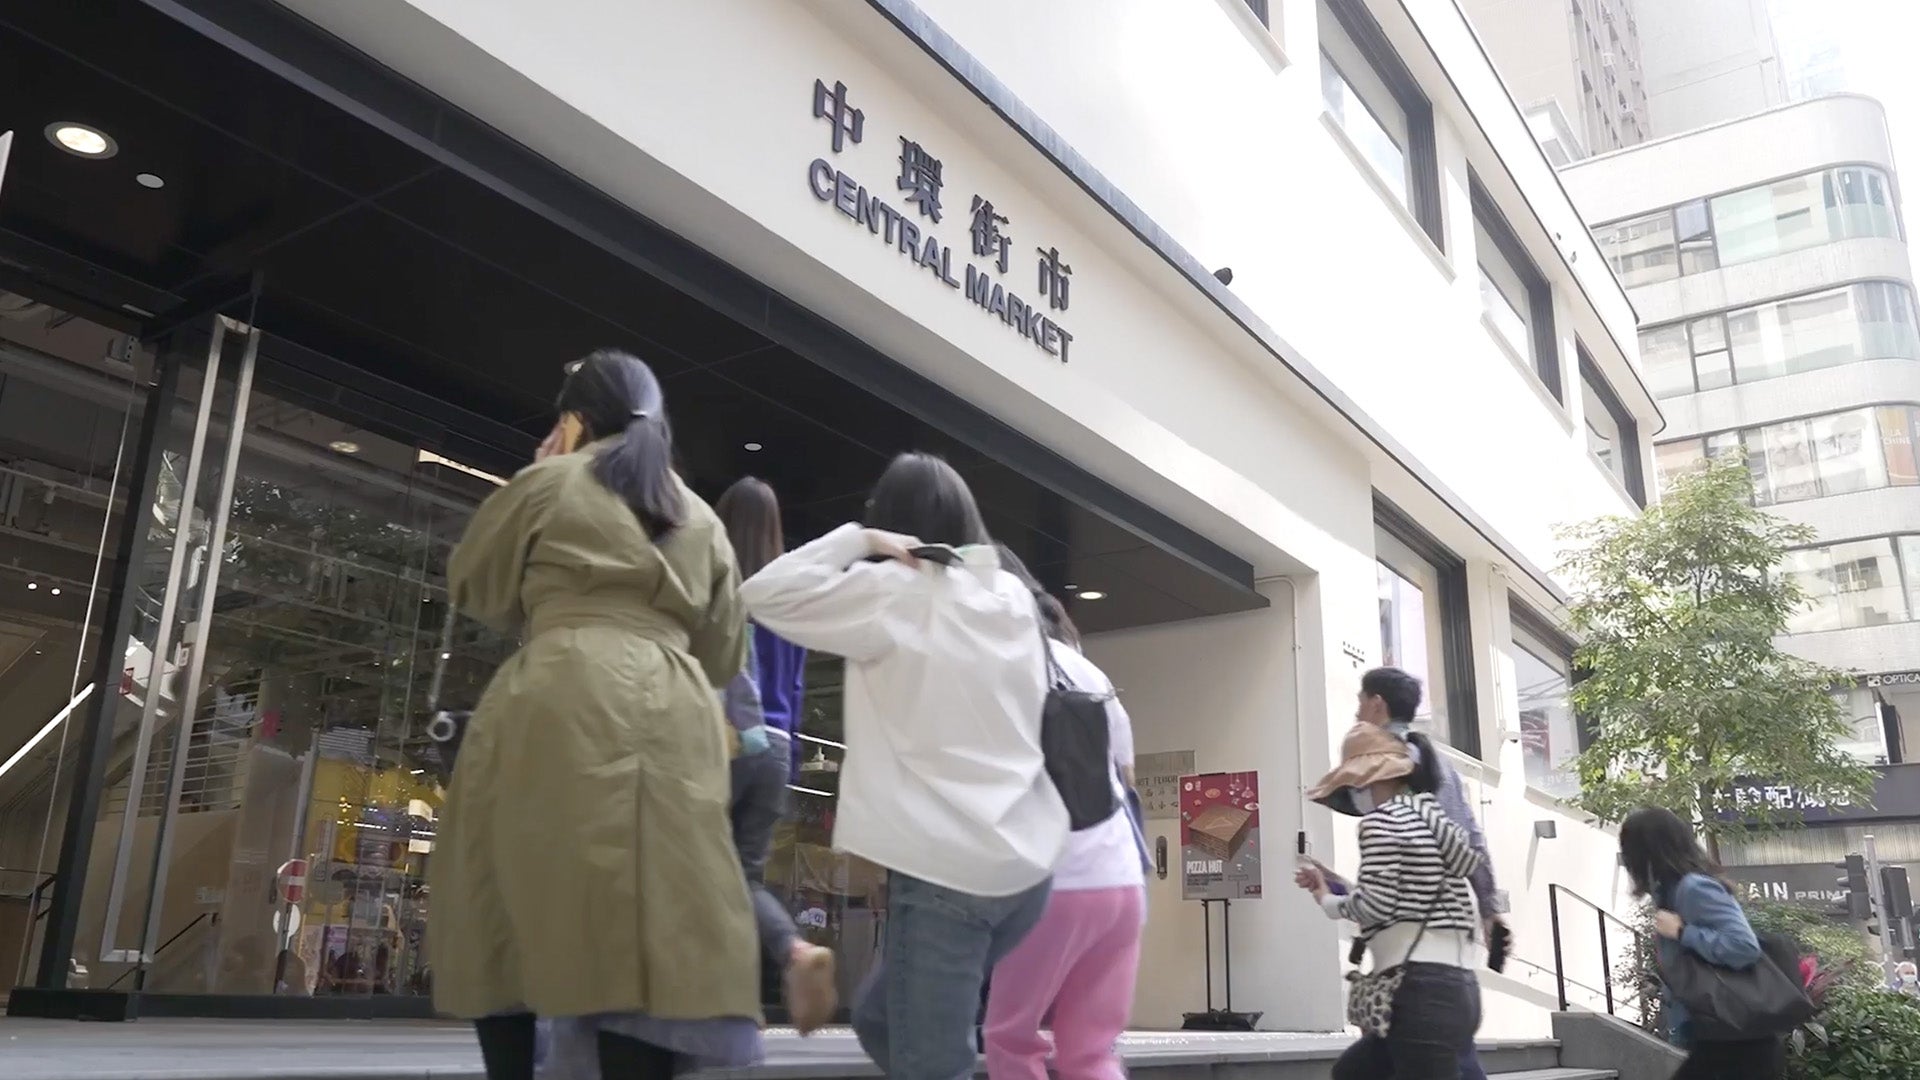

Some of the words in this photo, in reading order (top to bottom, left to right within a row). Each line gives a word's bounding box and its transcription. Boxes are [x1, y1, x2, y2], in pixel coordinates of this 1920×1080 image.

[809, 158, 960, 289] CENTRAL
[965, 263, 1073, 363] MARKET
[813, 78, 1073, 310] 中環街市
[1186, 860, 1208, 874] PIZZA
[1208, 859, 1223, 873] HUT
